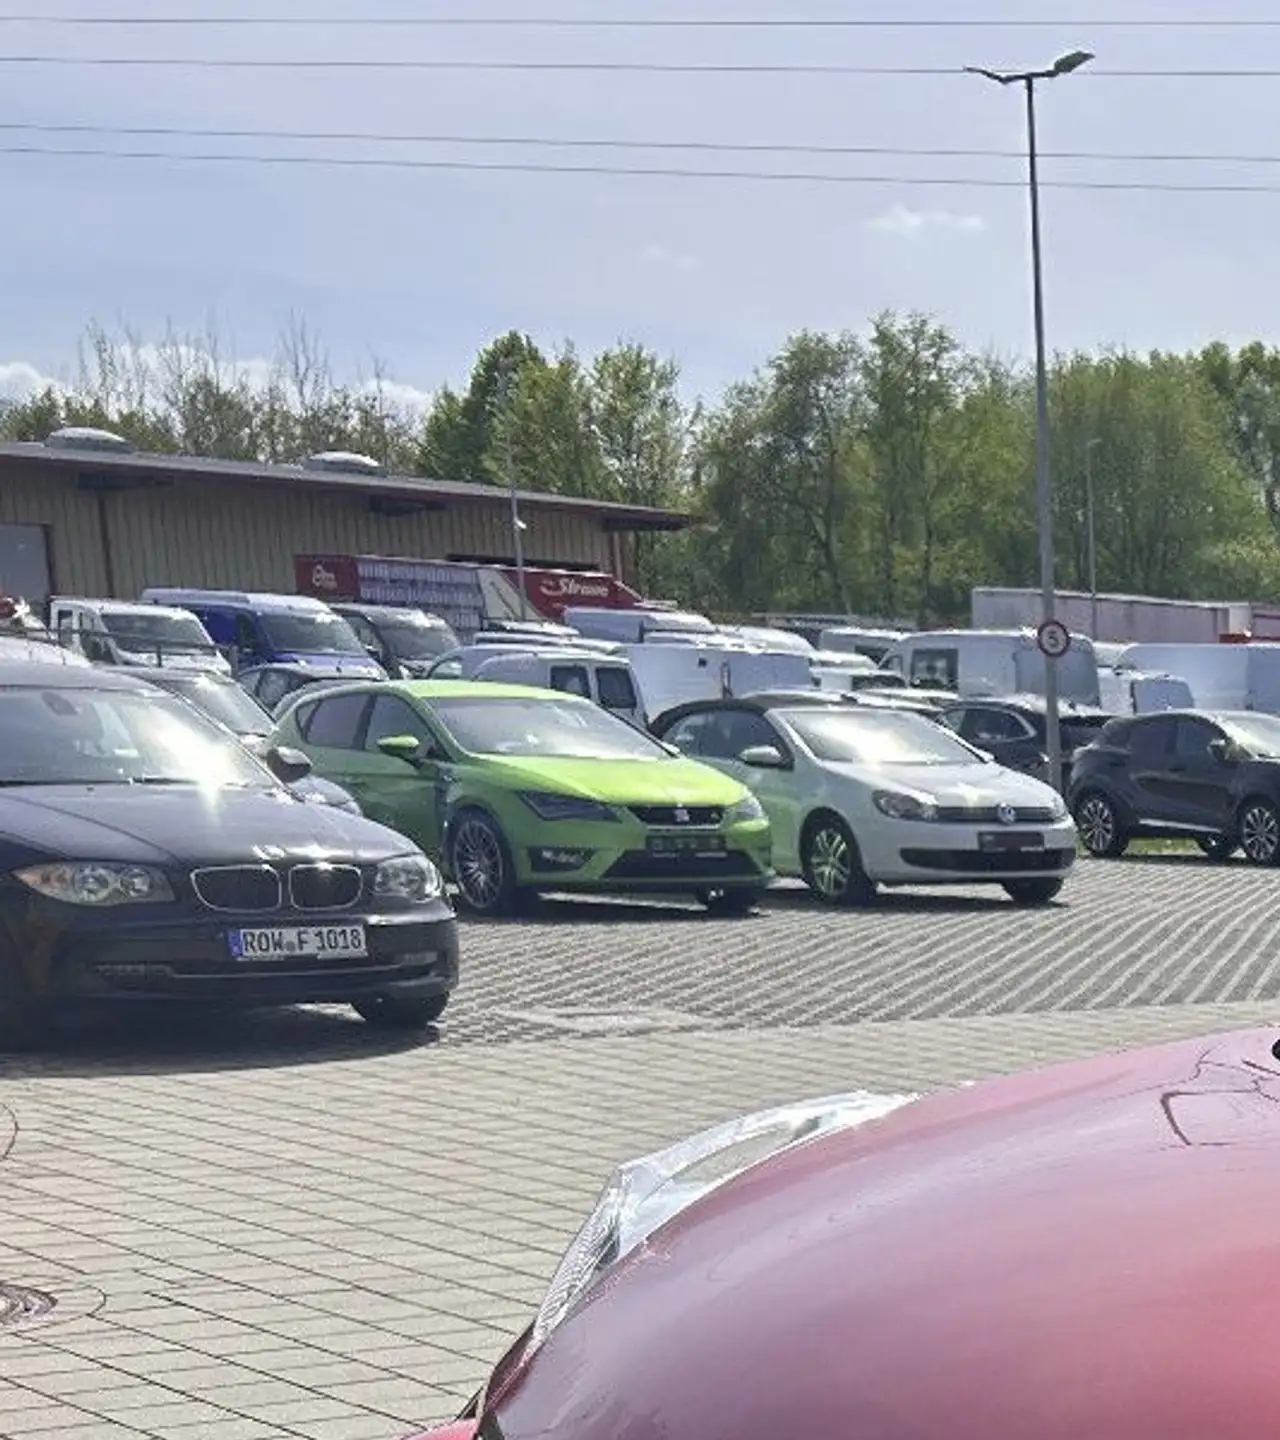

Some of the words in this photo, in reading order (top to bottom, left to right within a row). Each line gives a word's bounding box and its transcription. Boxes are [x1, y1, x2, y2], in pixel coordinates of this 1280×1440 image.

[1047, 630, 1060, 649] 5
[242, 931, 283, 953] ROW
[296, 929, 310, 951] F
[314, 928, 361, 951] 1018
